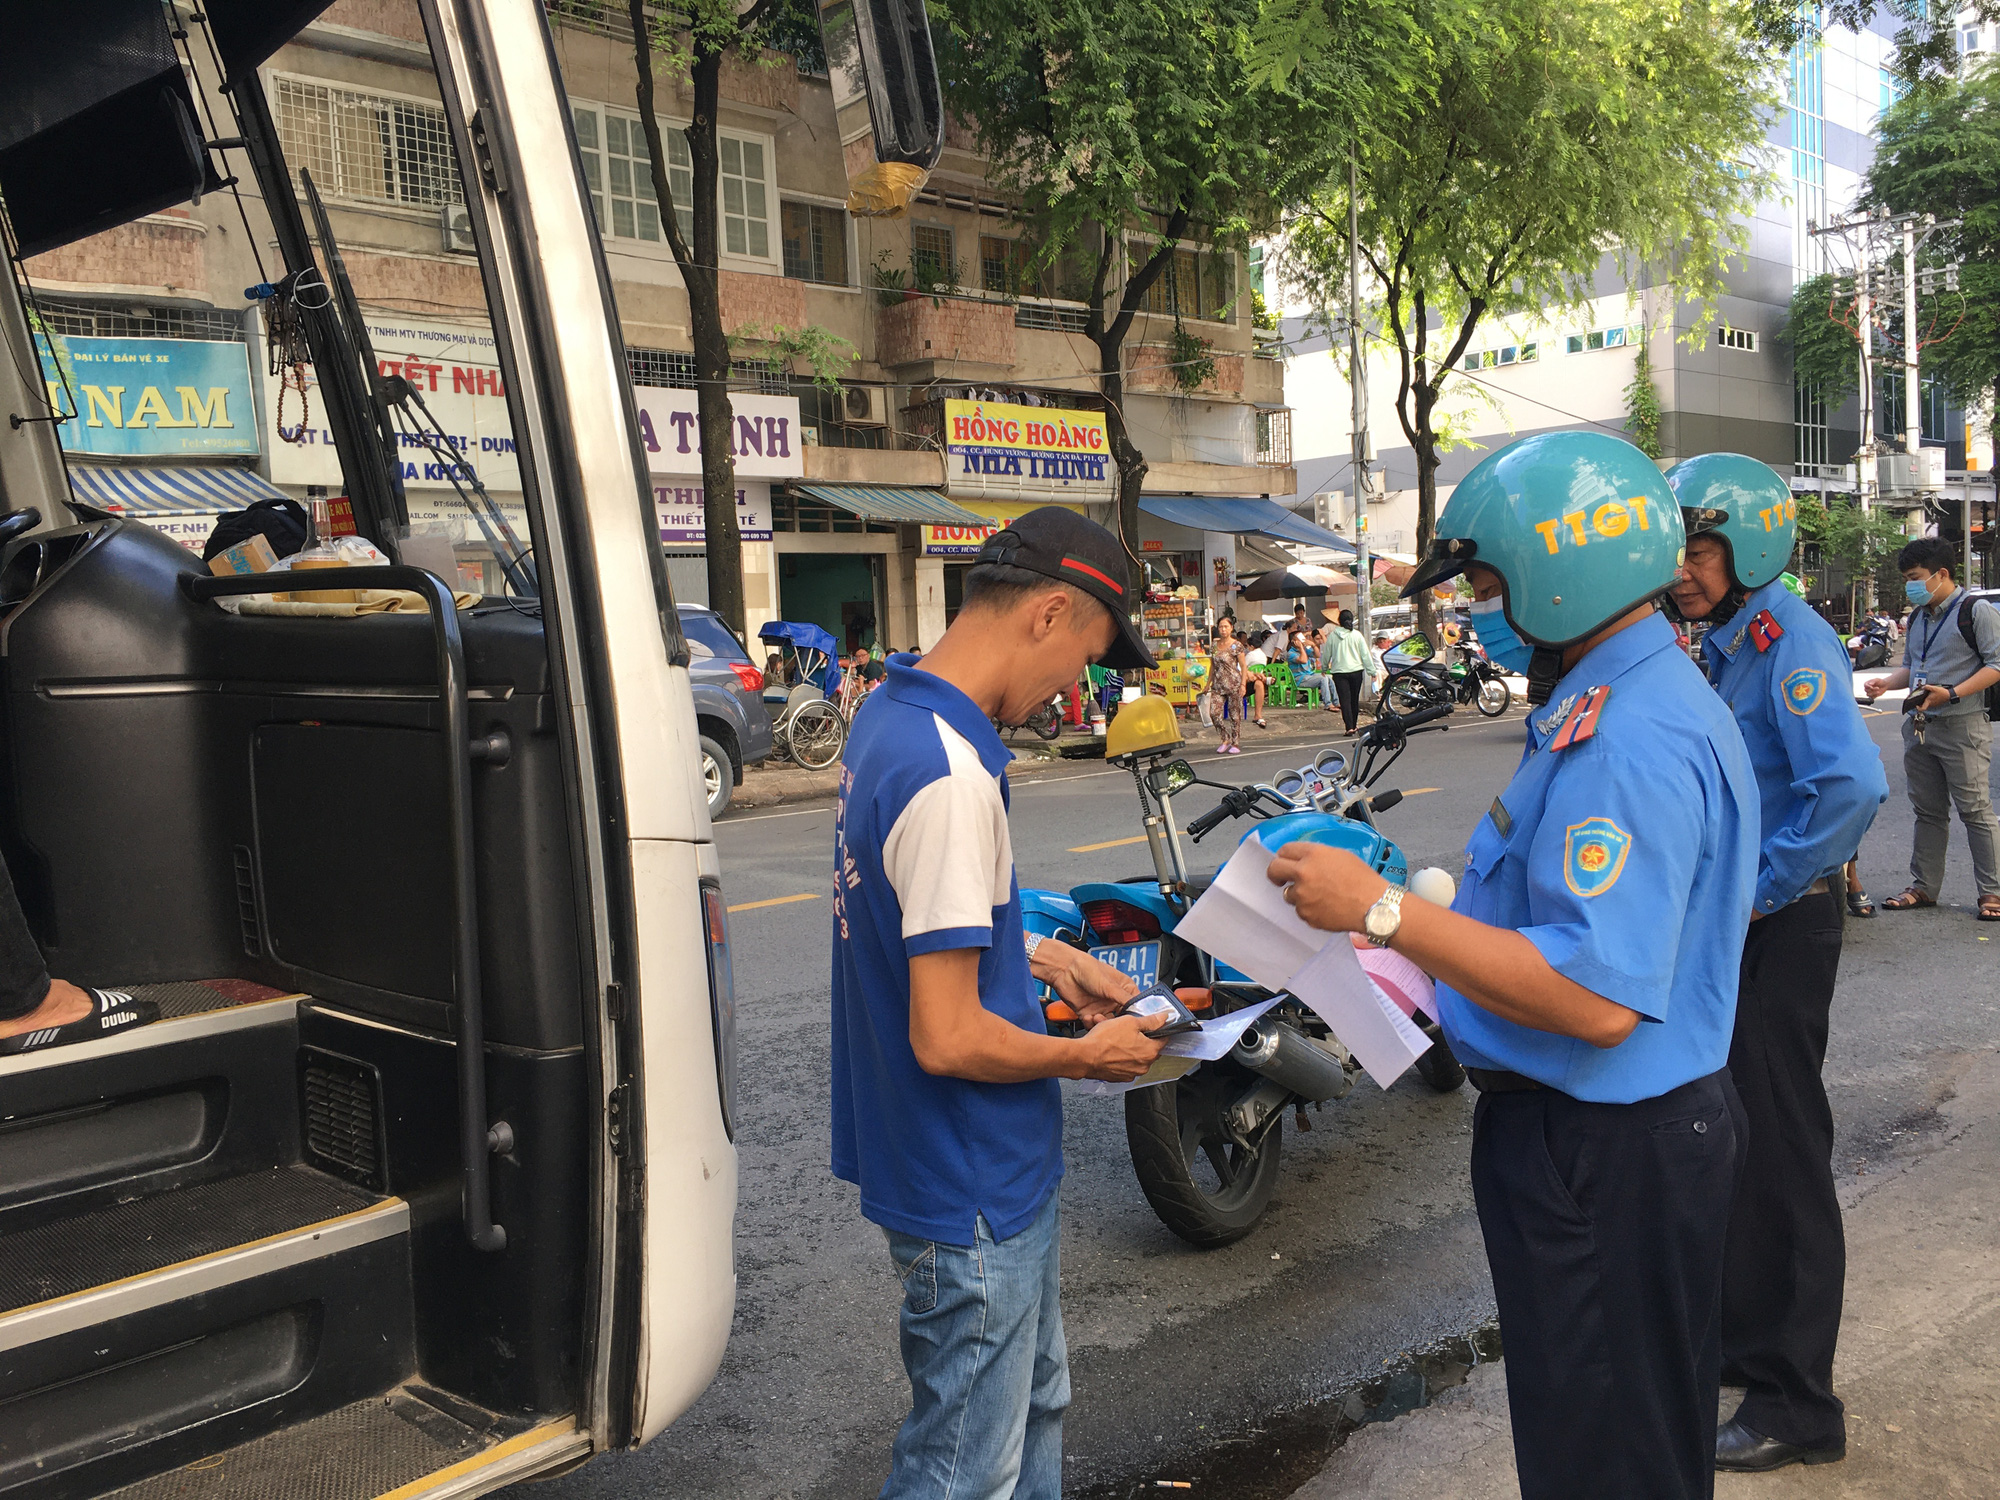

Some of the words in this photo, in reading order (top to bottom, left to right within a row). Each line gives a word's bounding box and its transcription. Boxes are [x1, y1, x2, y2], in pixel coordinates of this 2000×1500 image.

[374, 327, 397, 337] TNHH
[399, 329, 416, 339] MTV
[418, 330, 451, 342] THƯƠNG
[452, 335, 466, 345] MẠI
[467, 333, 477, 344] VÀ
[74, 353, 92, 362] ĐẠI
[96, 353, 109, 361] LÝ
[113, 353, 137, 362] BÁN
[81, 385, 234, 428] NAM
[281, 423, 317, 448] VẬT
[953, 404, 1020, 443] HỒNG
[1025, 418, 1104, 449] HOÀNG
[447, 435, 468, 455] BỊ
[670, 411, 791, 467] TỊNH
[984, 447, 1004, 455] HÙNG
[1031, 449, 1055, 459] ĐƯỜNG
[963, 455, 1023, 475] NHA
[1029, 457, 1106, 486] THỊNH
[654, 487, 746, 509] THỊH
[661, 512, 703, 525] THIẾT
[739, 512, 757, 525] TẾ
[1535, 496, 1650, 555] TTGT
[961, 545, 980, 553] HÙNG
[1173, 685, 1188, 694] THỊT
[1099, 946, 1147, 972] 59-A1
